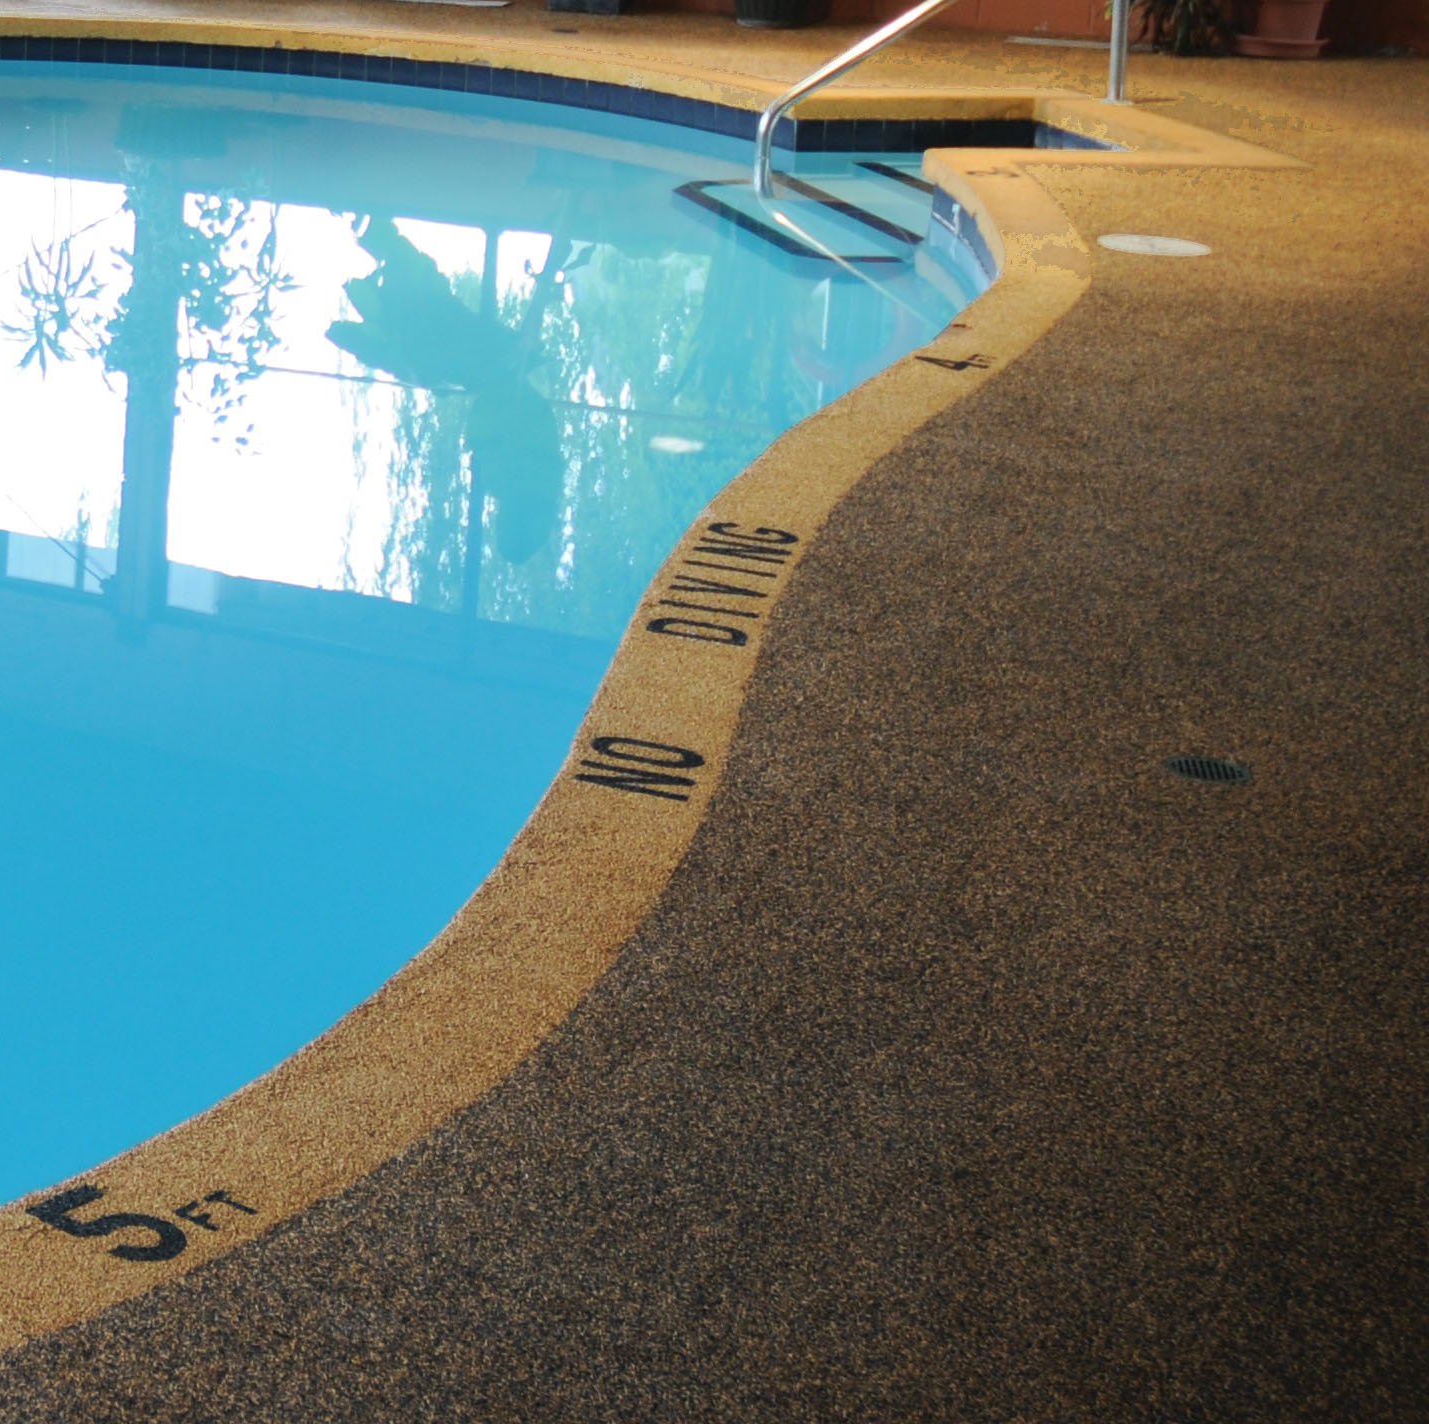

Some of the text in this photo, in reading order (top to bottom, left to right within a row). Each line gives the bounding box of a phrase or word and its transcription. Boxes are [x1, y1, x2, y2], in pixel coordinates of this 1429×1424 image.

[575, 522, 799, 802] NO DIVING
[25, 1183, 259, 1263] 5 FT
